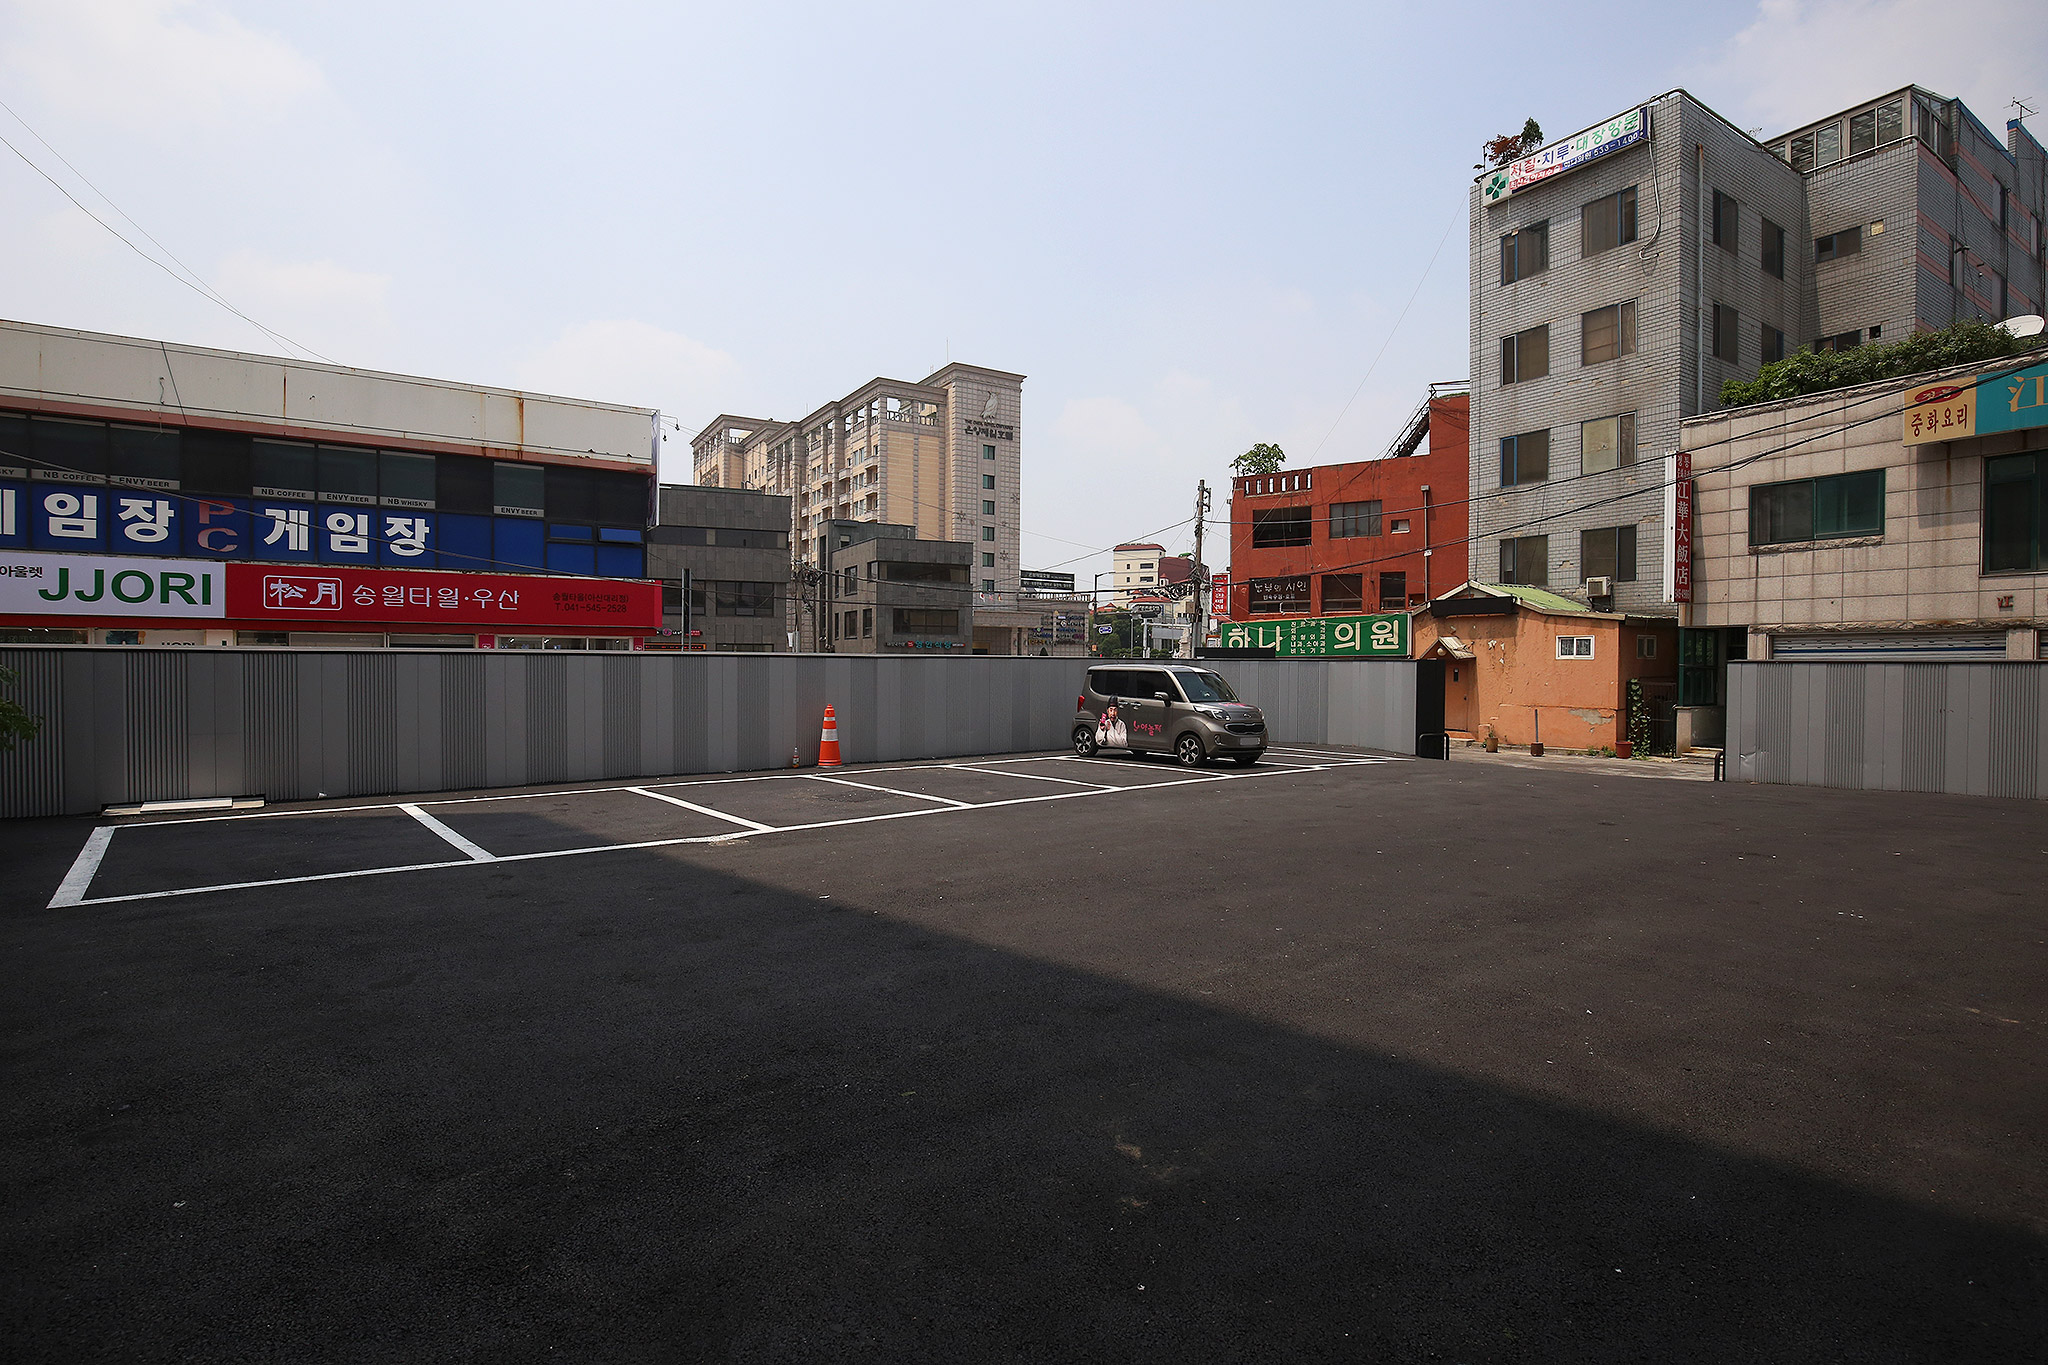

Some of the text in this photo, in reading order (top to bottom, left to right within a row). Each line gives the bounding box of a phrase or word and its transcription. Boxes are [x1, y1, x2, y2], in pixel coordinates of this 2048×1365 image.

[1911, 404, 1967, 437] 중화요리
[62, 473, 97, 482] COFFEE
[119, 477, 170, 488] ENVY BEER
[261, 488, 306, 499] NB COFFEE
[326, 493, 369, 503] ENVY BEER
[388, 497, 428, 507] NB WHISKY
[501, 506, 538, 516] ENVY BEER
[263, 508, 430, 557] 게임장
[1676, 481, 1689, 585] 江華大飯店
[0, 565, 43, 579] 아울렛
[38, 567, 212, 606] JJORI
[269, 579, 337, 606] 松月
[1334, 619, 1400, 651] 의원
